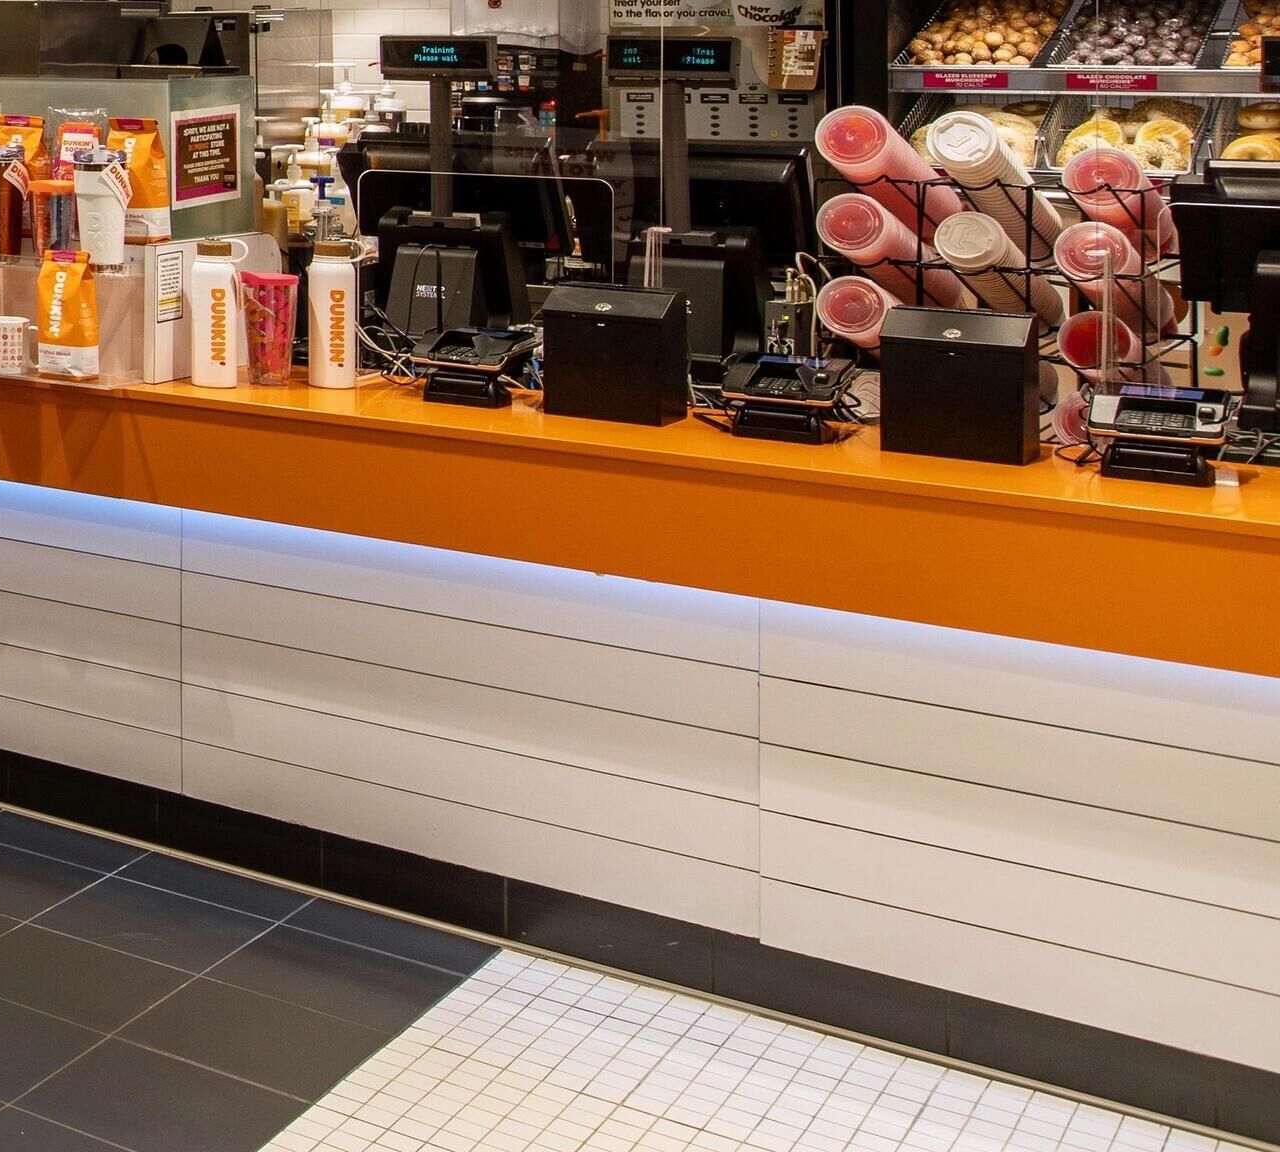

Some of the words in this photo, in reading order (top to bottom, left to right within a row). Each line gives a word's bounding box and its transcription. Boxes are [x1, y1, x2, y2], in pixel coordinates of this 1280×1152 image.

[750, 5, 771, 13] HOT
[613, 9, 624, 18] to
[625, 9, 642, 18] the
[677, 10, 696, 20] you
[698, 8, 731, 18] crave!
[422, 46, 455, 54] Training
[414, 54, 438, 62] Please
[442, 54, 458, 62] wait
[200, 126, 207, 134] WE
[190, 132, 223, 143] PARTICIPATING
[210, 140, 225, 148] STORE
[200, 150, 209, 158] THIS
[194, 175, 209, 183] THANK
[49, 271, 68, 339] DUNKIN'
[210, 288, 226, 366] DUNKIN'
[330, 290, 345, 368] DUNKIN'
